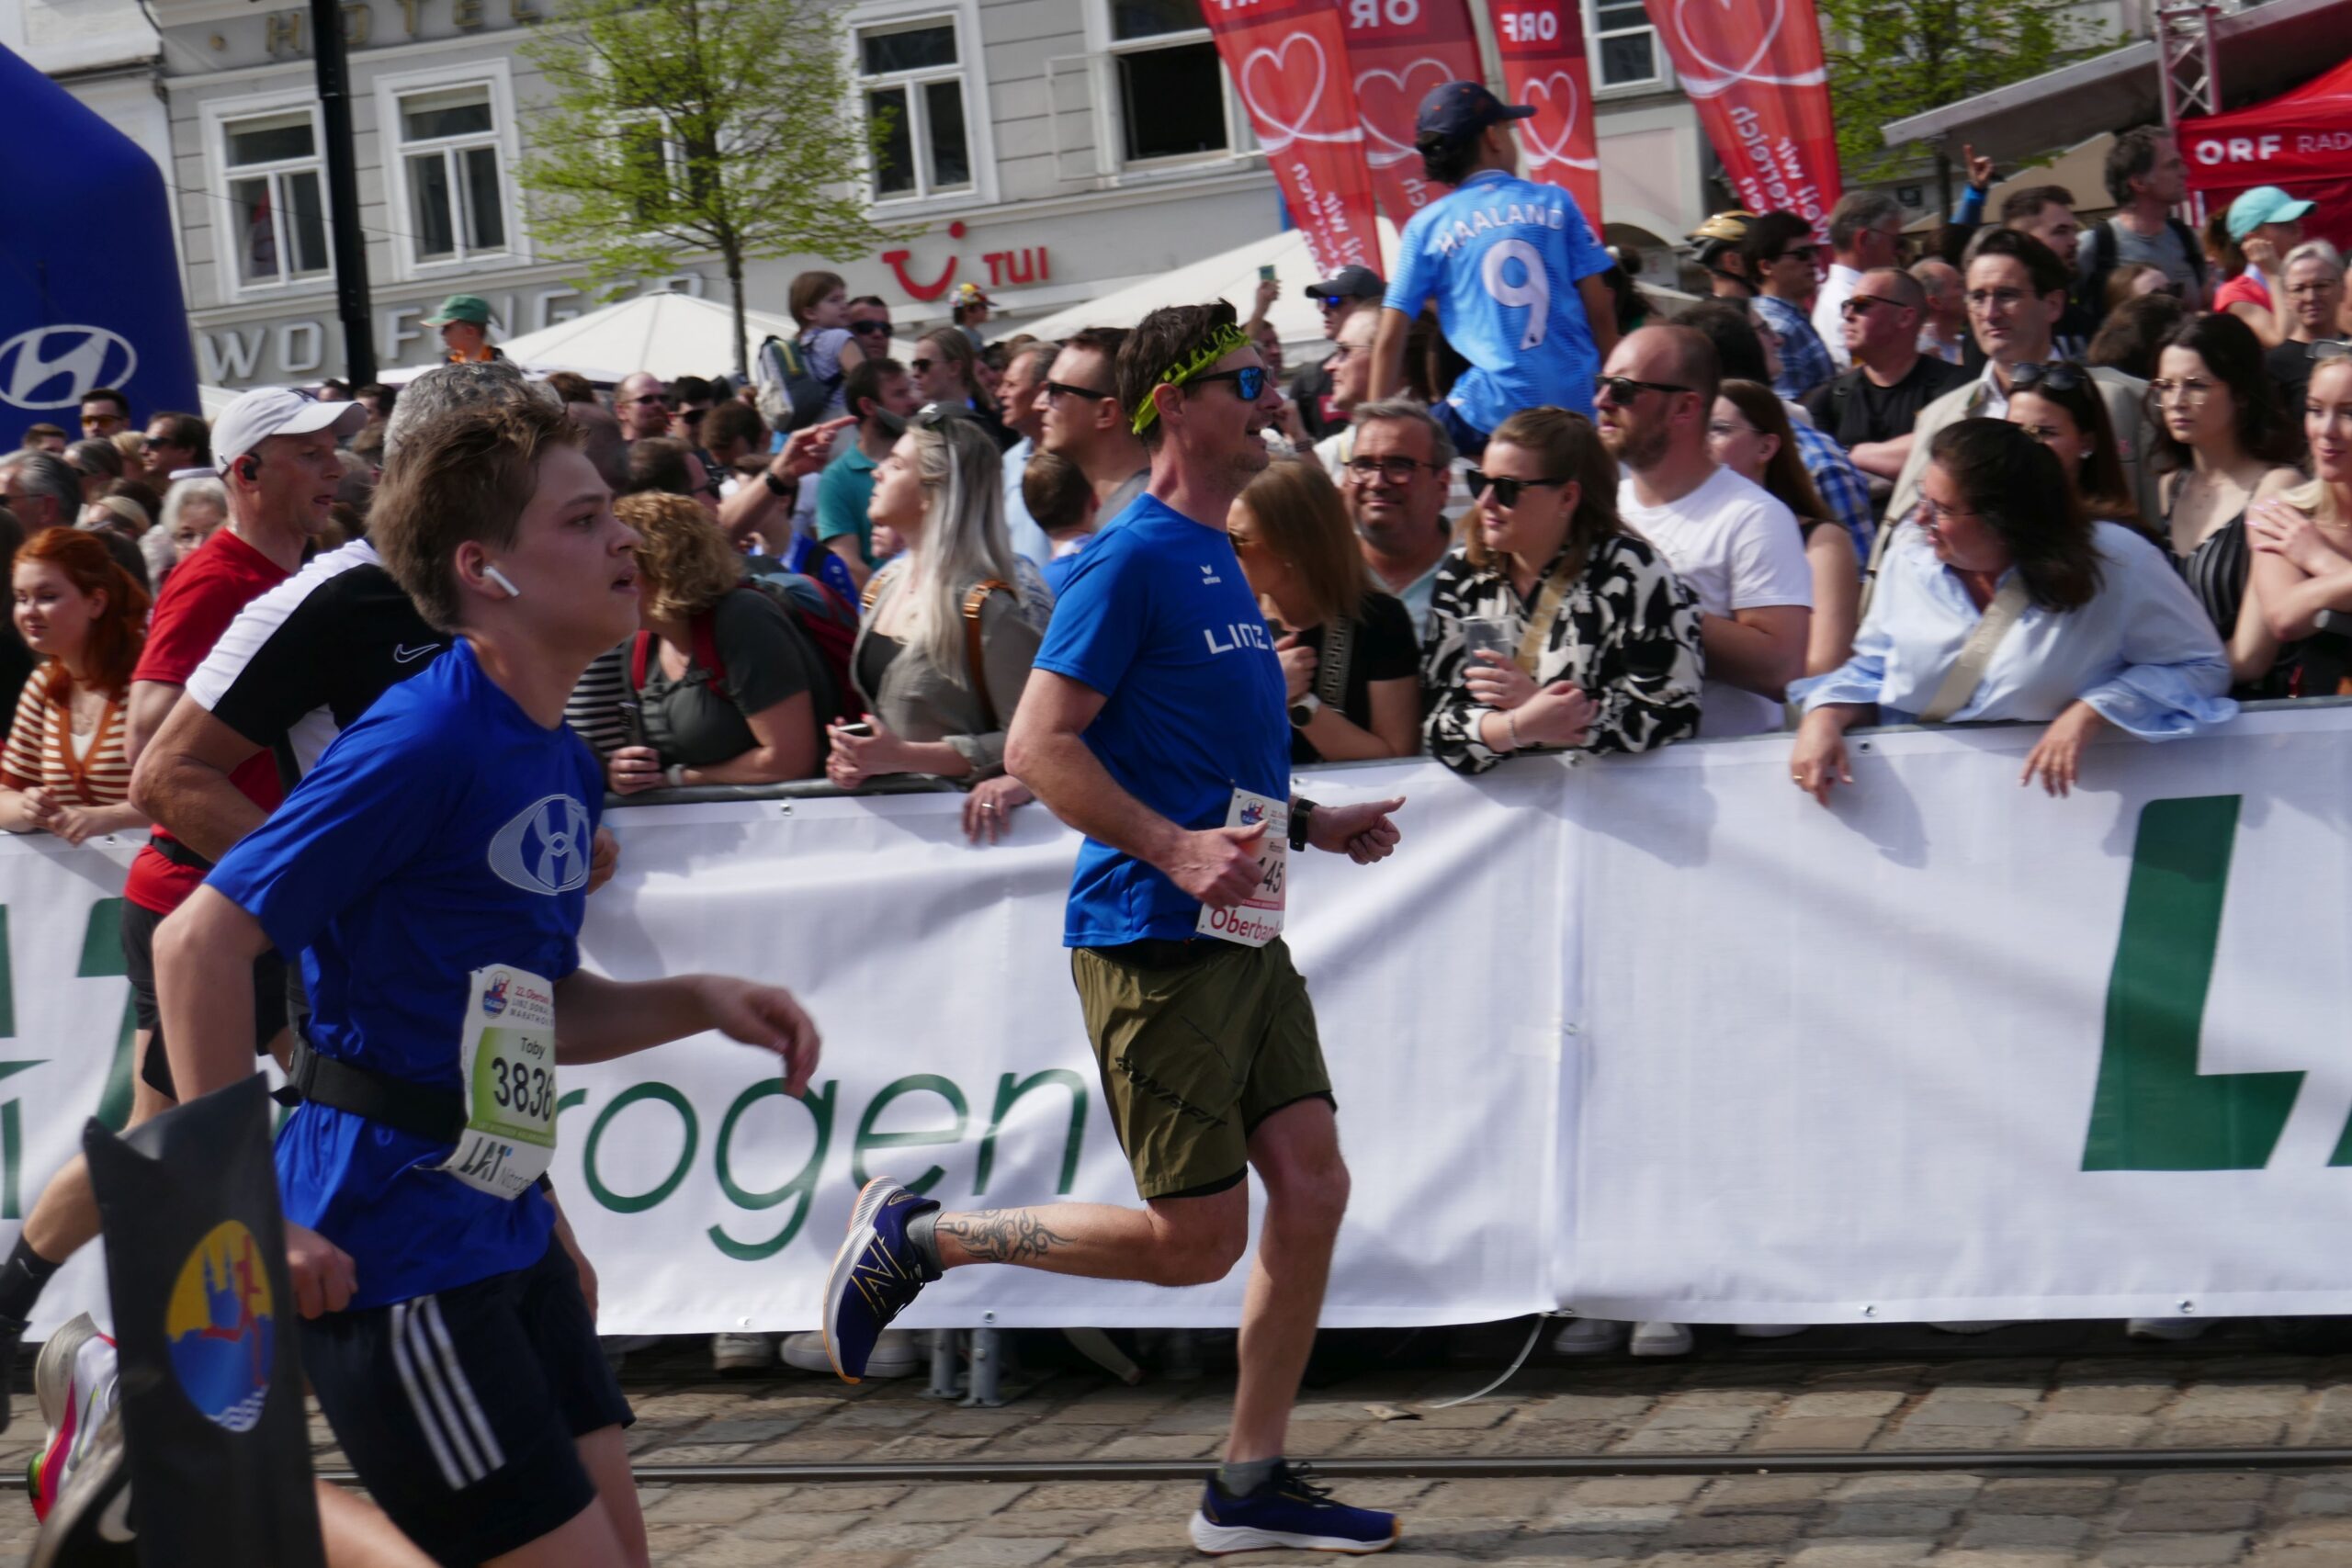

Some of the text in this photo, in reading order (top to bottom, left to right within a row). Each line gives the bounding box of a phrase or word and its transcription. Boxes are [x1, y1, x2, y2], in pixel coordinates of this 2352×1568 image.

[2195, 134, 2283, 165] ORF
[981, 245, 1051, 288] TUI
[1481, 238, 1551, 351] 9
[2081, 794, 2352, 1172] L
[521, 1036, 546, 1060] Toby
